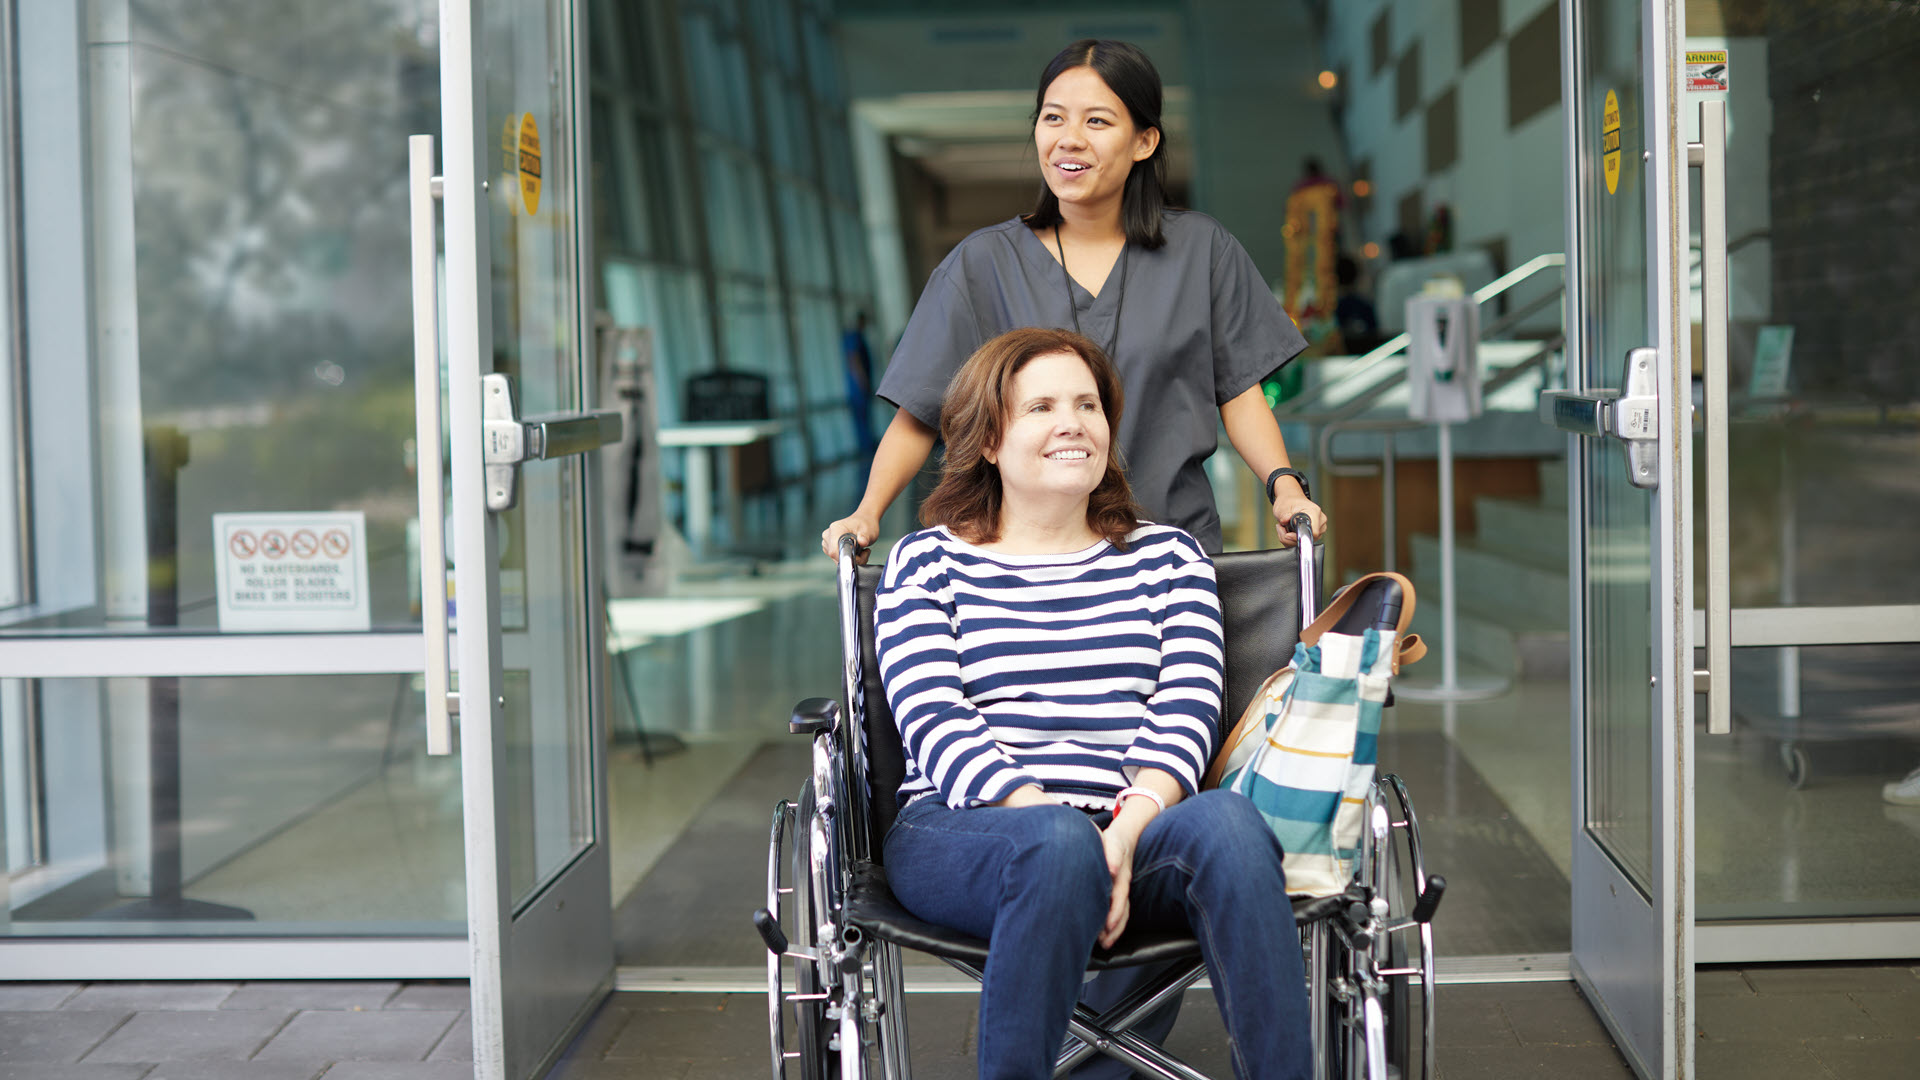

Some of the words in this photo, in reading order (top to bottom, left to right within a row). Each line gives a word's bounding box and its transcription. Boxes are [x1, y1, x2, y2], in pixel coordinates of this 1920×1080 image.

[1686, 53, 1724, 62] ARNING
[240, 564, 255, 575] NO
[245, 577, 287, 588] ROLLER
[234, 590, 266, 601] BIKES
[272, 590, 287, 601] OR
[295, 590, 351, 601] SCOOTERS
